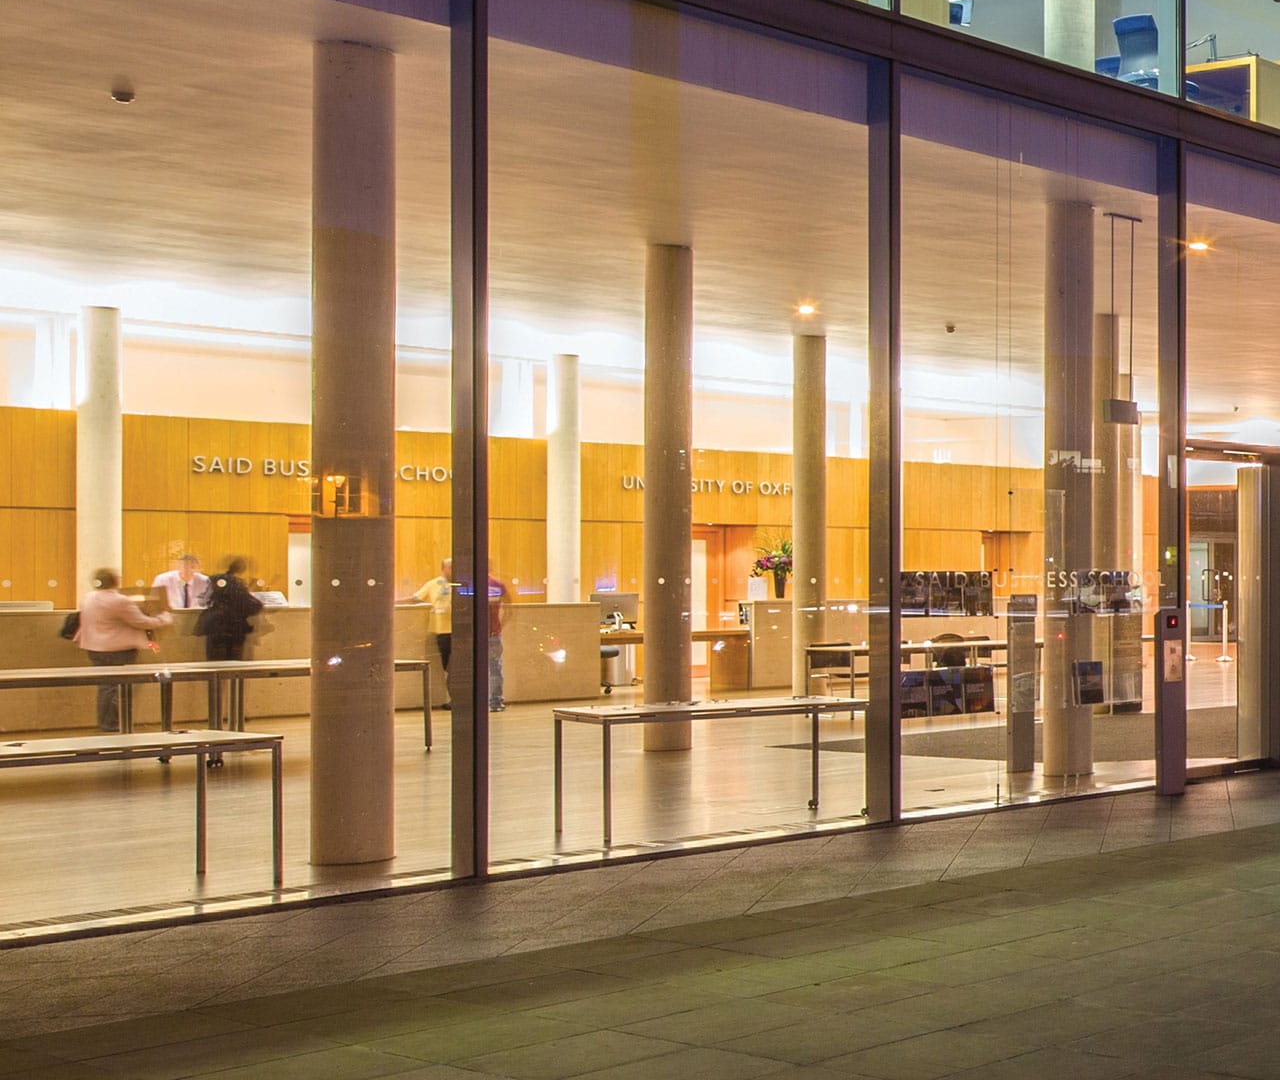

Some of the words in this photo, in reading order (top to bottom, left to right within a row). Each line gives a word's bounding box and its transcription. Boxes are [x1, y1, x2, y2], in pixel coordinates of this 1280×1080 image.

[192, 455, 252, 475] SAID
[395, 464, 452, 483] CHO
[622, 475, 726, 494] UNSITY
[731, 479, 754, 495] OF
[759, 481, 794, 496] OXF
[915, 571, 968, 589] SAID
[980, 570, 1078, 588] BUSINESS
[1087, 569, 1167, 587] SCHOOL
